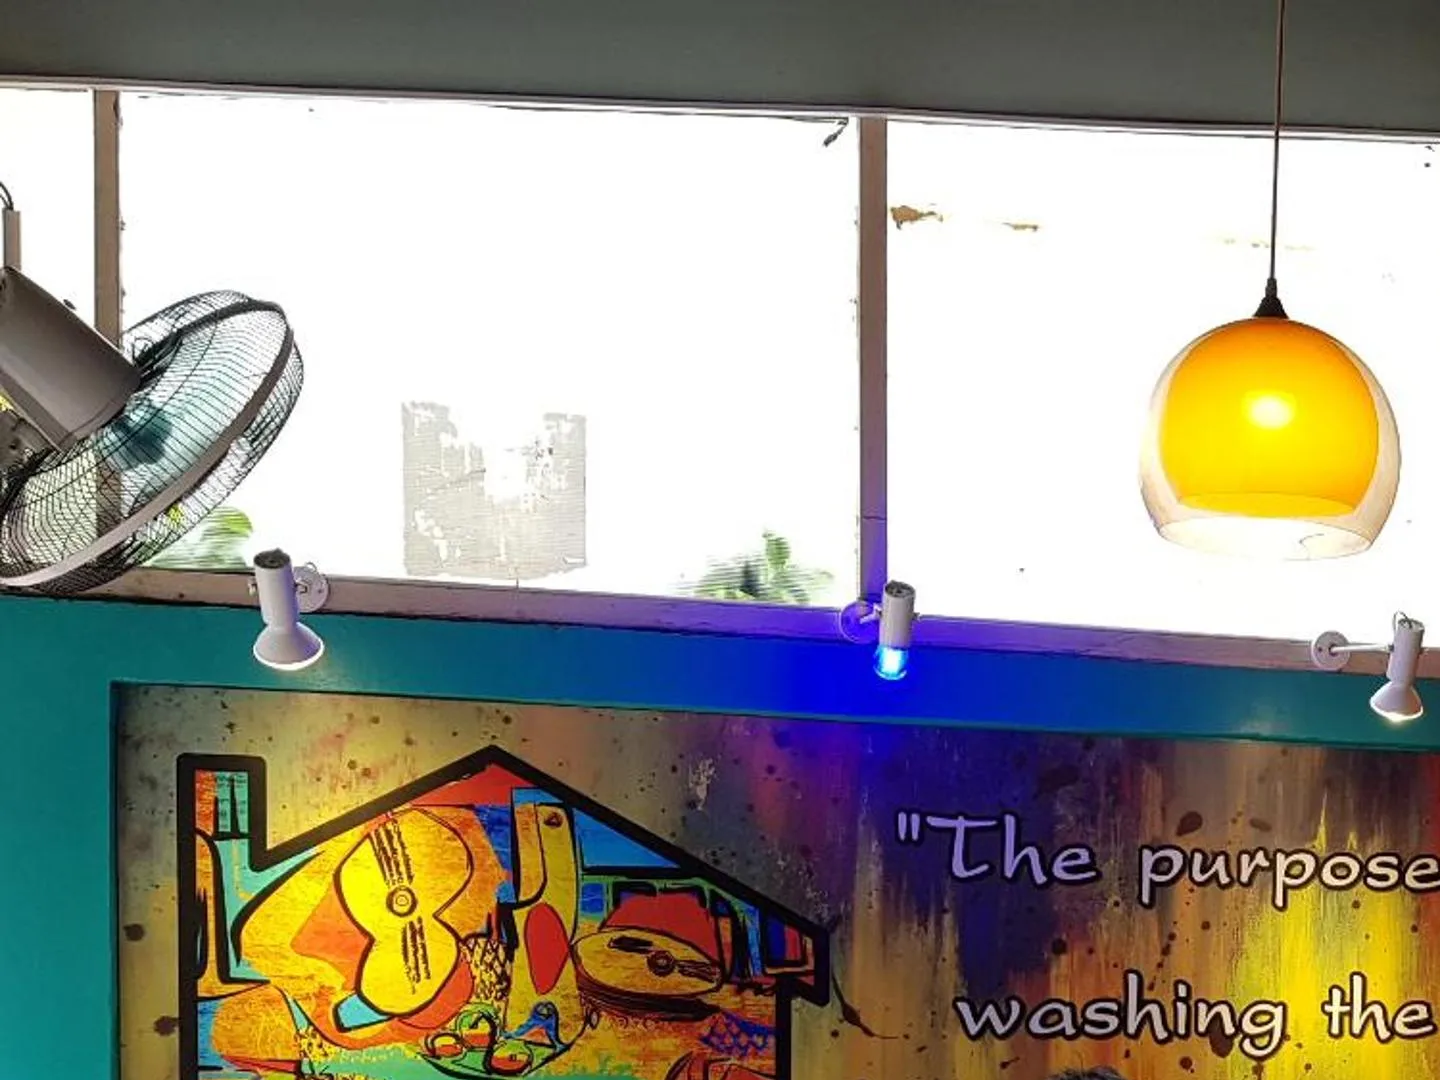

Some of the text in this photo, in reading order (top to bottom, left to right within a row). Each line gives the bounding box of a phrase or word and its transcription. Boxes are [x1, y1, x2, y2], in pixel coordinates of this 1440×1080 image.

[896, 811, 1099, 888] "The
[954, 971, 1288, 1059] washing
[1323, 971, 1437, 1041] the
